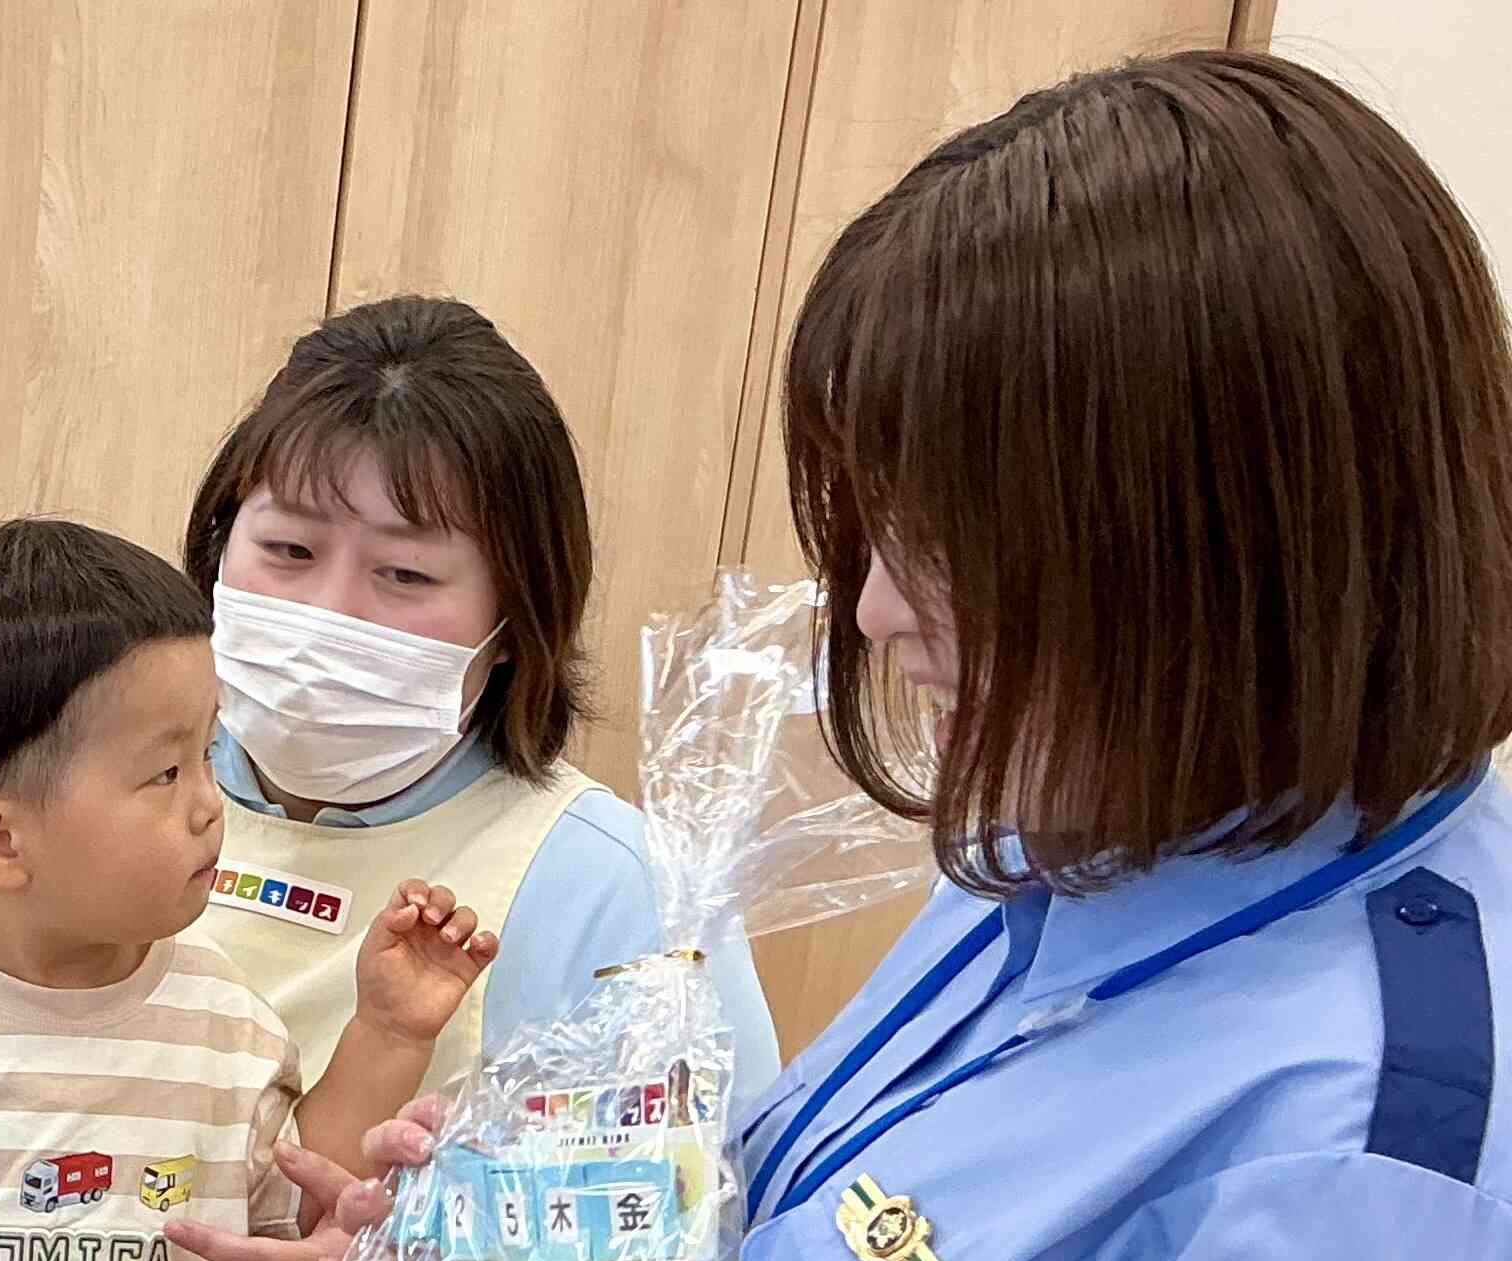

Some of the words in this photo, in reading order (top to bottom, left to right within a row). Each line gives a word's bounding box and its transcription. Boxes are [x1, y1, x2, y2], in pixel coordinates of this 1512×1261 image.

[505, 1203, 519, 1237] 5
[549, 1194, 572, 1233] 木
[617, 1193, 651, 1231] 金
